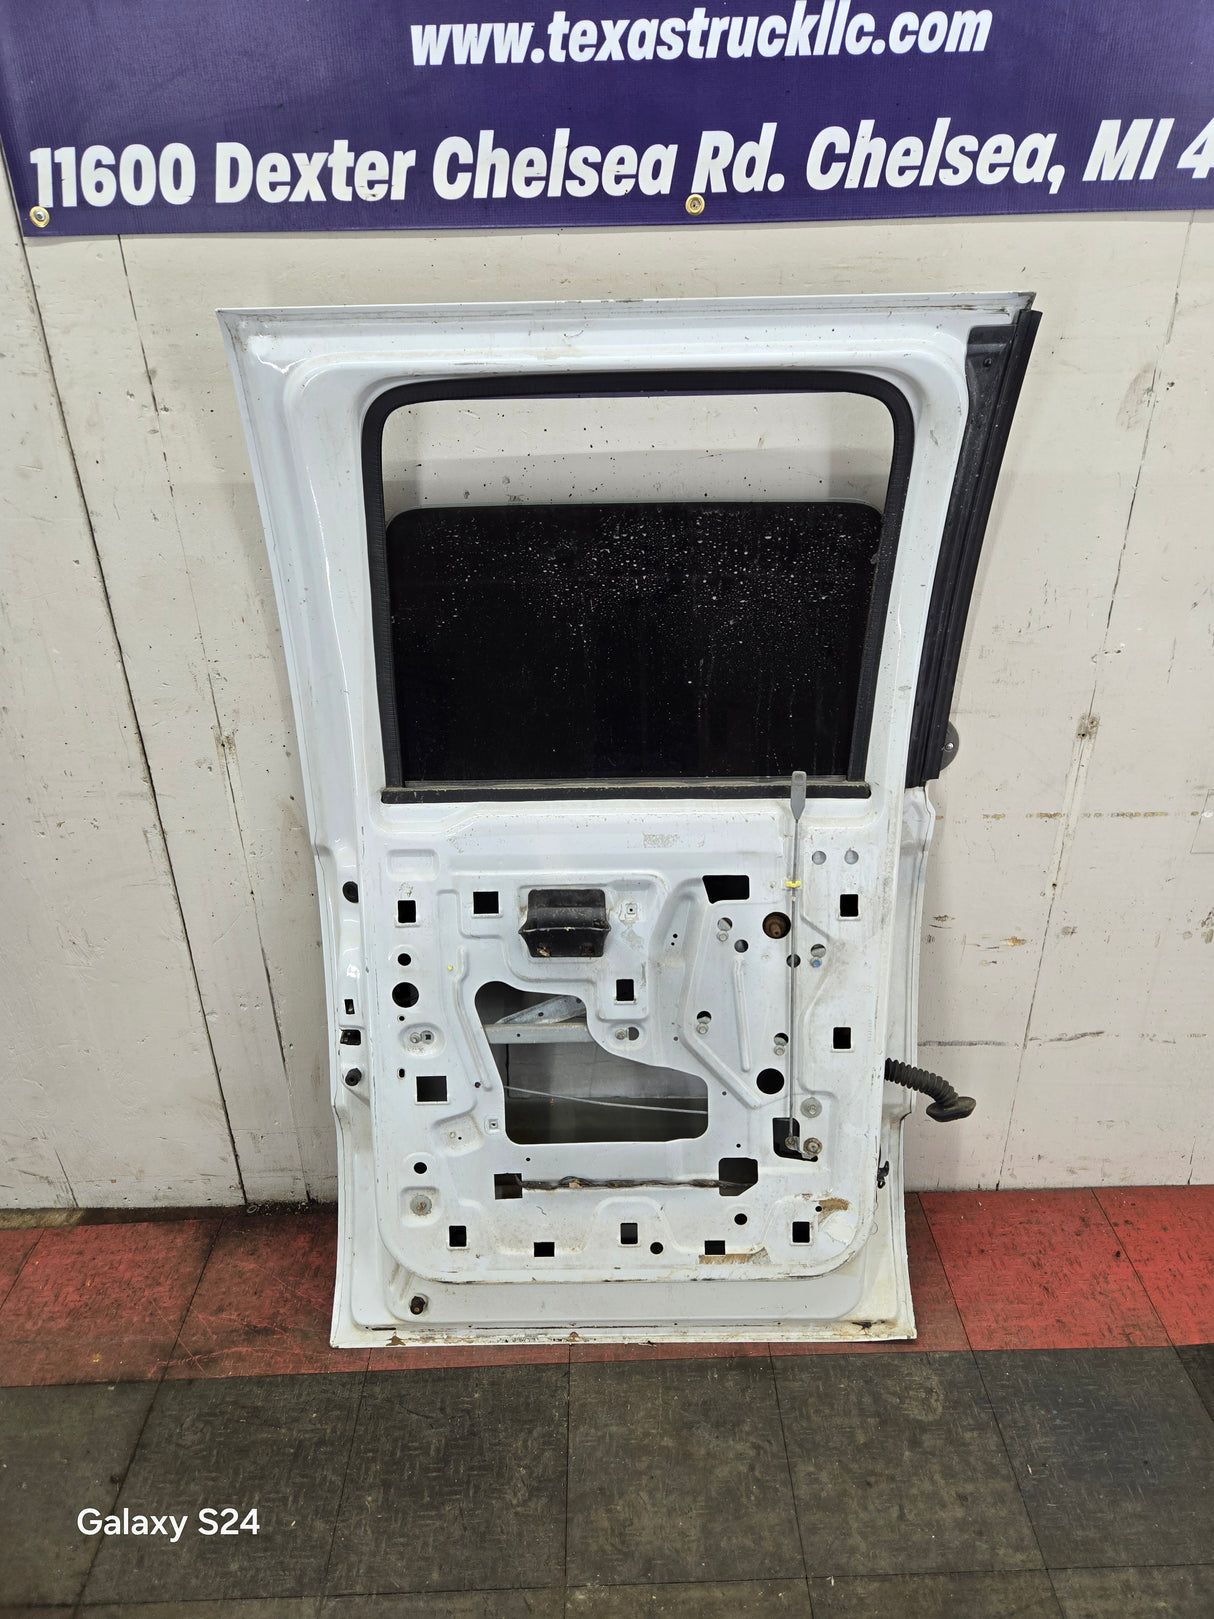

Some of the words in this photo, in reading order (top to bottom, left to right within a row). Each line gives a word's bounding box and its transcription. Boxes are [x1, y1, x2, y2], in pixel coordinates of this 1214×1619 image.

[411, 0, 992, 66] www.texastruckllc.com
[29, 143, 196, 208] 11600
[215, 140, 417, 204] Dexter
[432, 128, 679, 200] Chelsea
[691, 123, 785, 194] Rd.
[806, 118, 1066, 195] Chelsea,
[1082, 117, 1176, 182] MI
